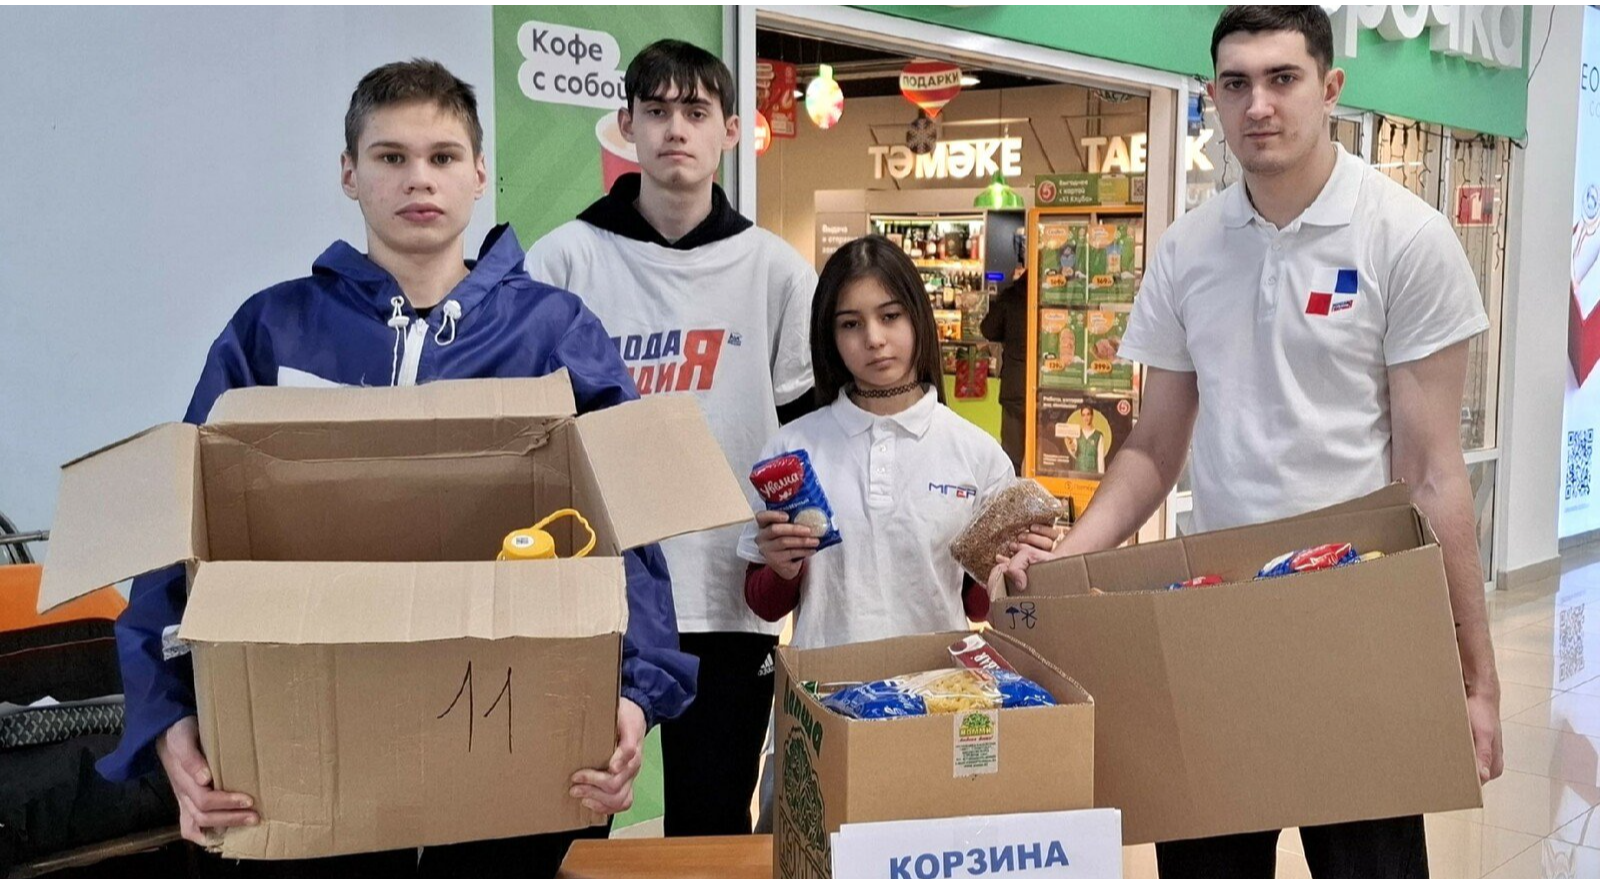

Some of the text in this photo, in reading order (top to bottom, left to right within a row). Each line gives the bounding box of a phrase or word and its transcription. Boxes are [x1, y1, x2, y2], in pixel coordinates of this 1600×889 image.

[532, 28, 603, 64] Кофе
[533, 71, 546, 90] с
[903, 71, 959, 88] ПОДАРКИ
[868, 137, 1022, 179] ТӘМӘКЕ
[437, 660, 512, 753] 11
[889, 840, 1070, 879] КОРЗИНА
